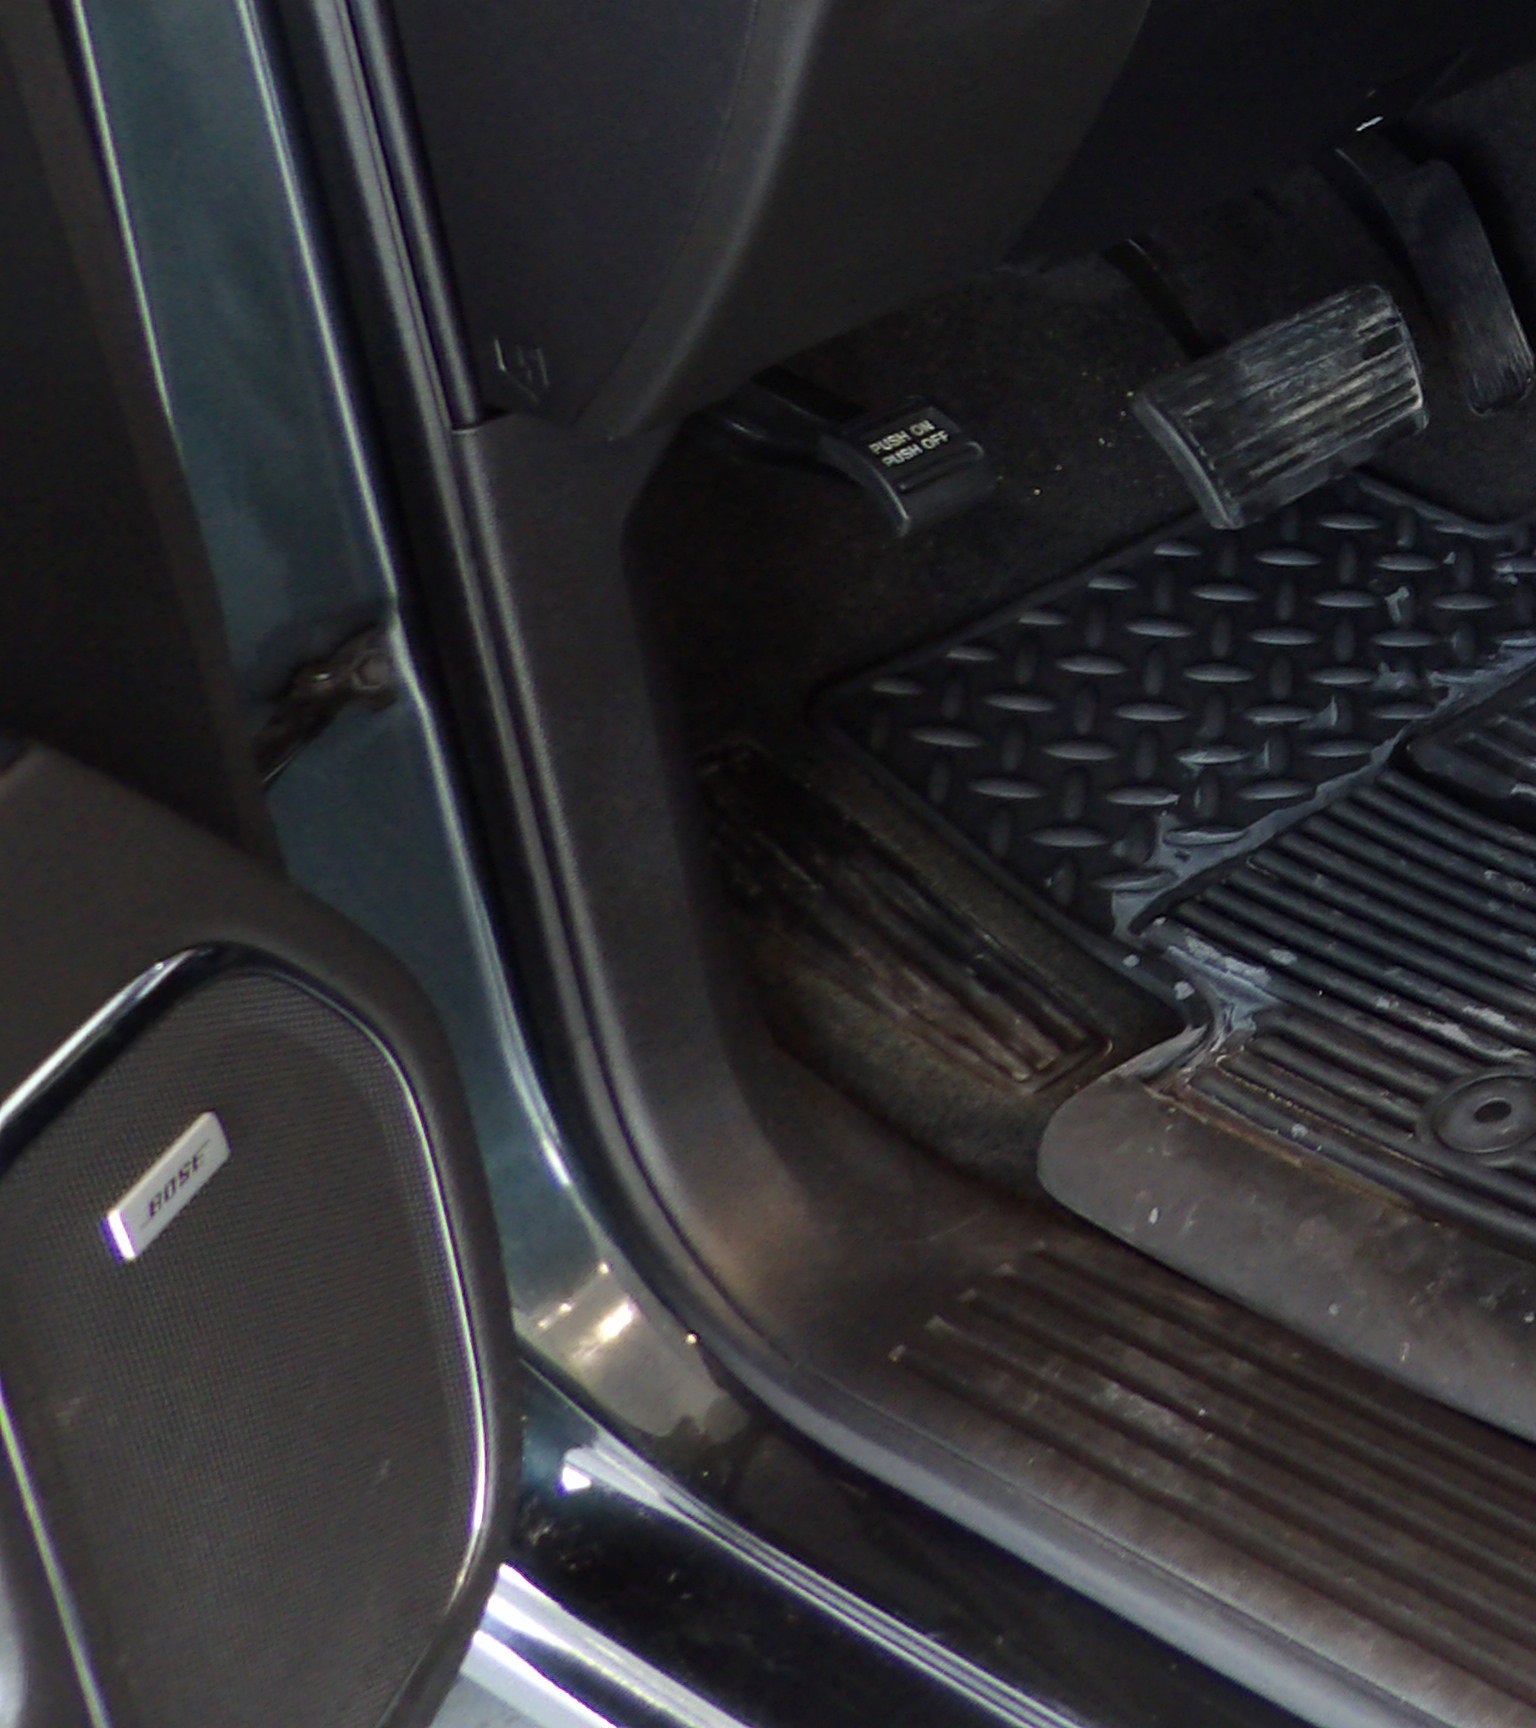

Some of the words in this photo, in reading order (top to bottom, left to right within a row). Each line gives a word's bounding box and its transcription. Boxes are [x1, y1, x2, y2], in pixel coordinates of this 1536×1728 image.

[869, 430, 912, 454] PUSH
[909, 419, 935, 437] ON
[881, 443, 923, 467] PUSH
[920, 430, 949, 450] OFF
